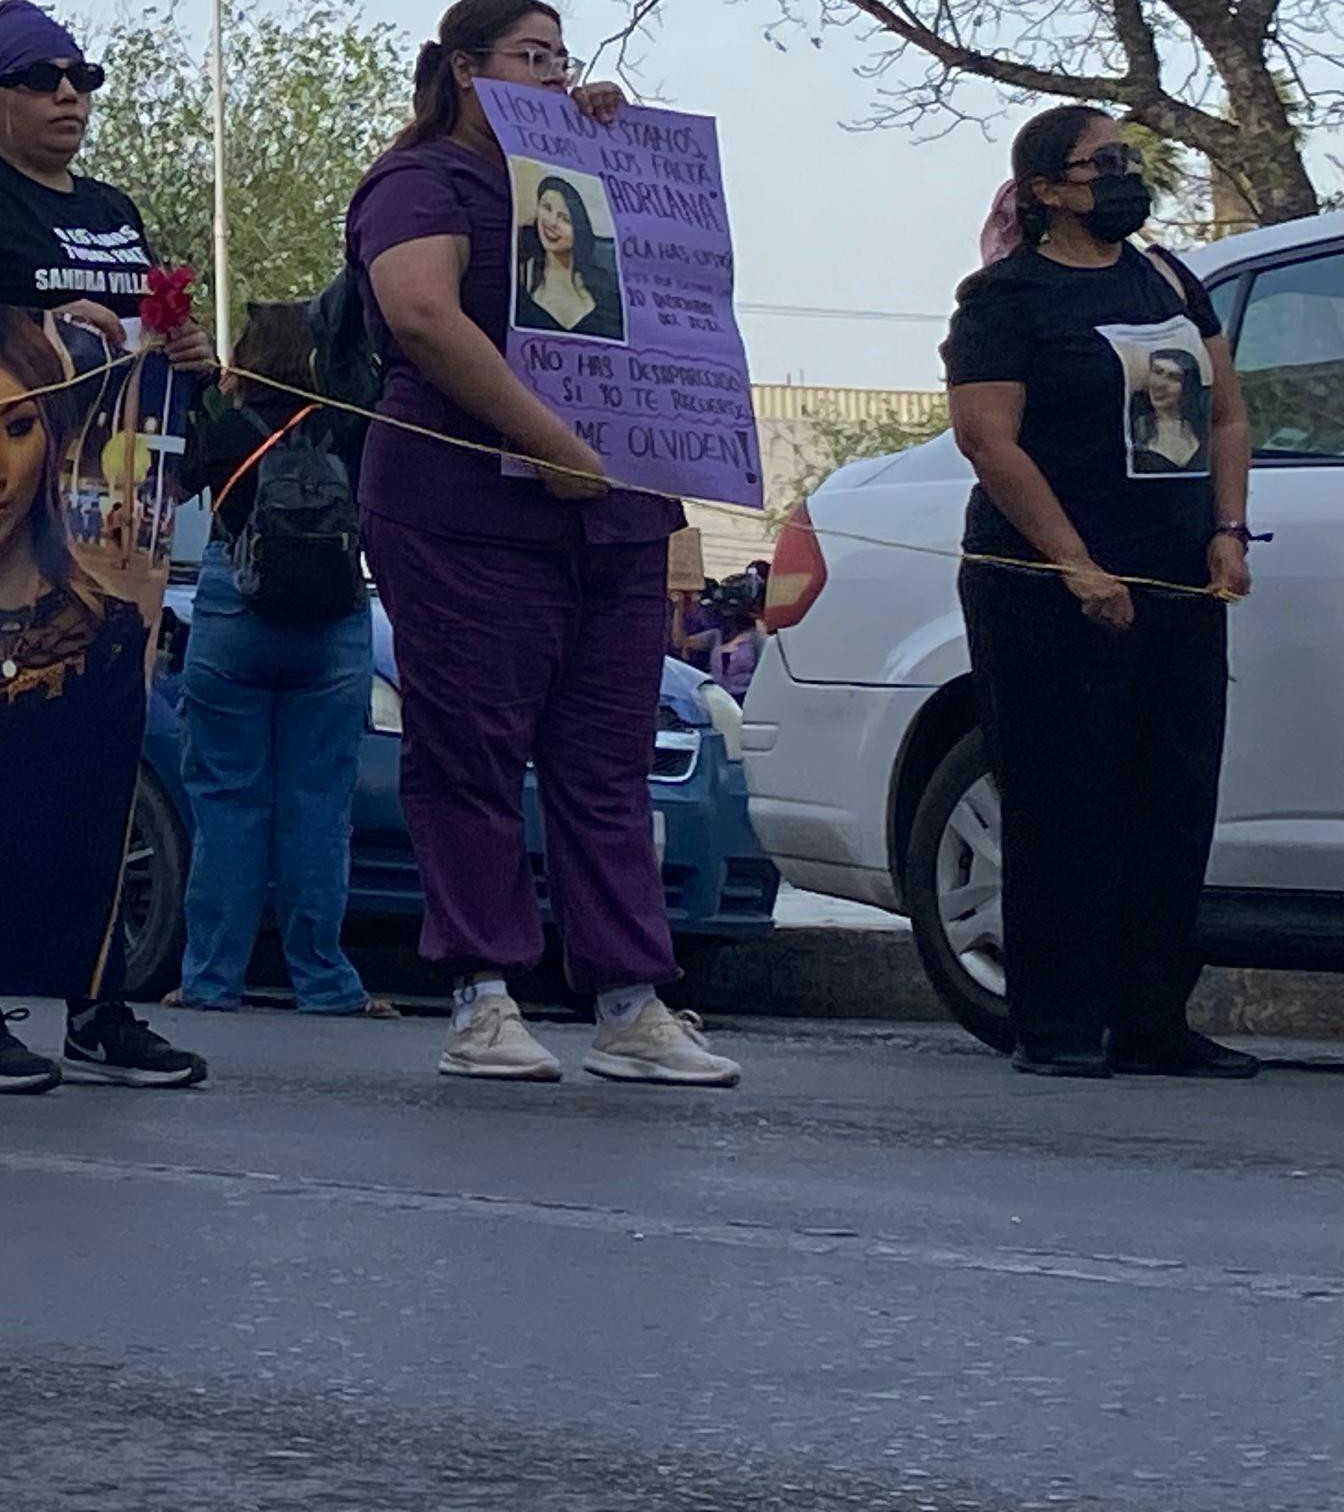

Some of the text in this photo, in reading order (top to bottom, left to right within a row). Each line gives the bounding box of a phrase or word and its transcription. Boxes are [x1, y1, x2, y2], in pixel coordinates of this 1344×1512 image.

[35, 268, 106, 292] SANDRA
[529, 344, 563, 372] NO
[563, 376, 583, 403] SI
